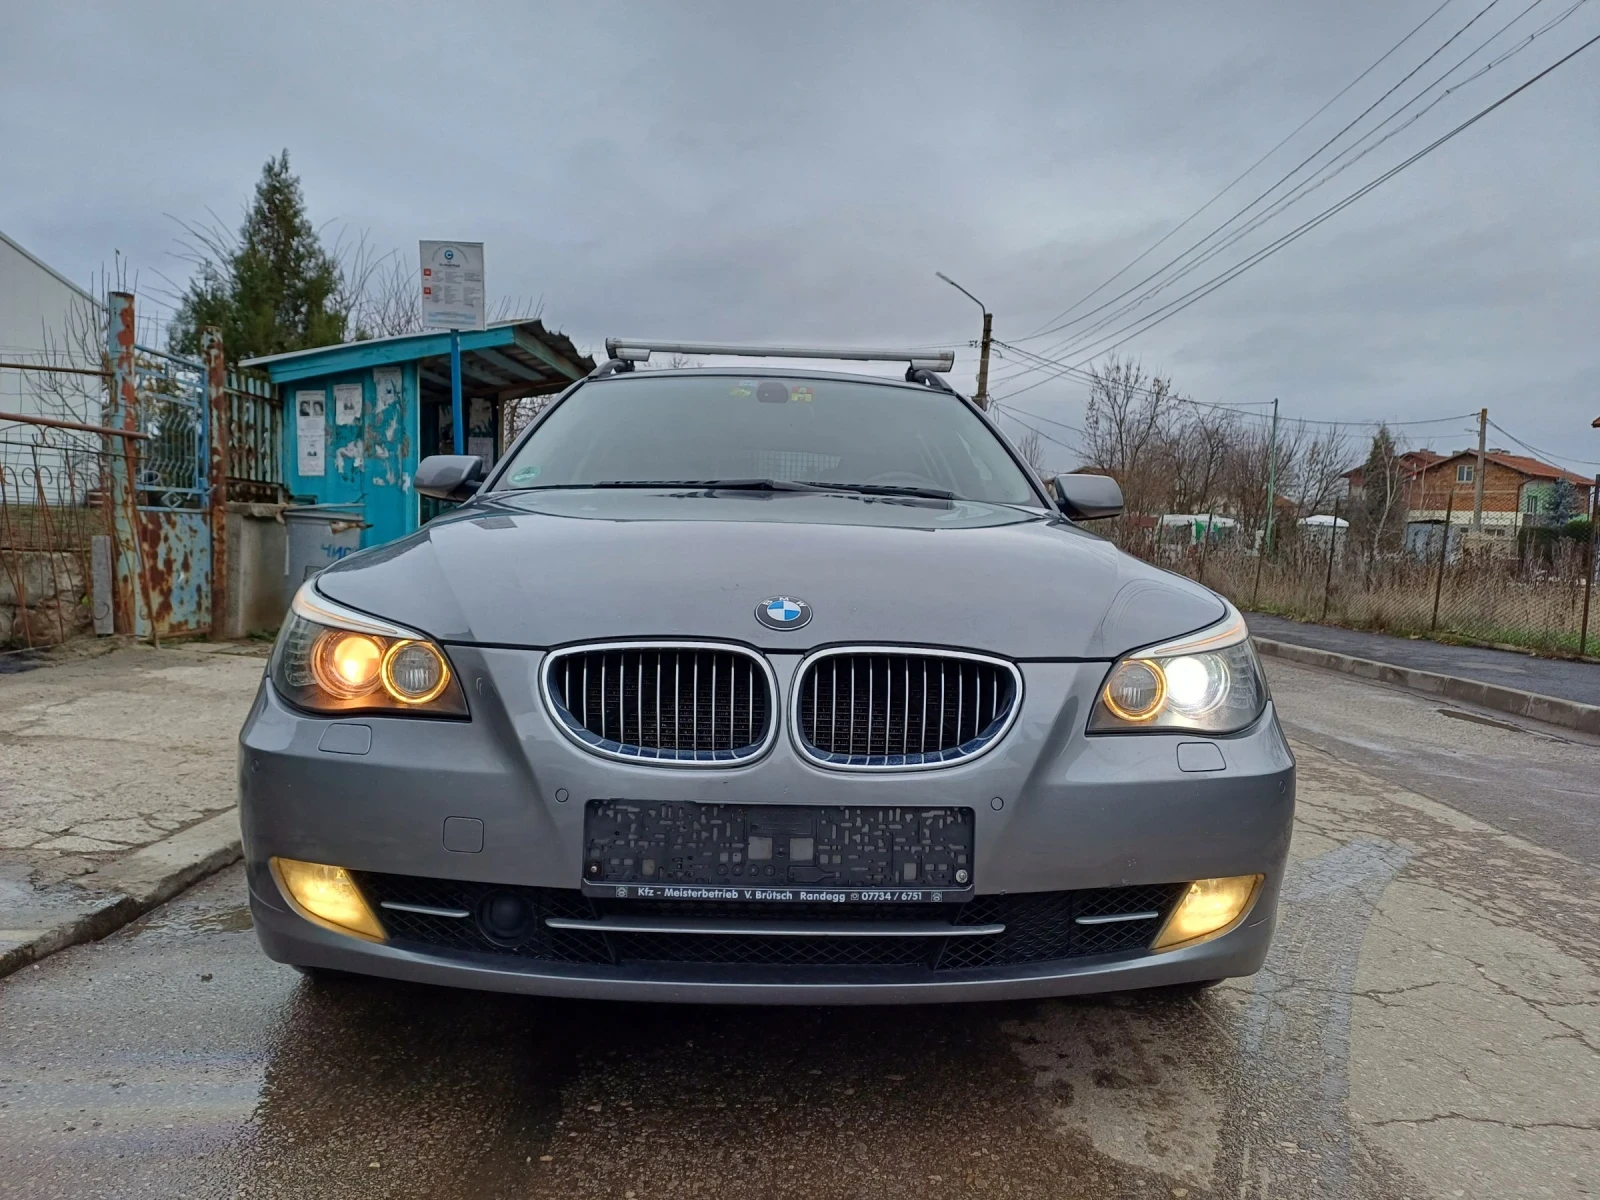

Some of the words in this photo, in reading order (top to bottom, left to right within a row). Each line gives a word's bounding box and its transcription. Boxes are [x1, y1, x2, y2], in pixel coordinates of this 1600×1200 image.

[762, 597, 807, 607] BMW
[637, 887, 654, 897] Kfz
[664, 888, 738, 899] Meisterbetrieb
[744, 890, 752, 899] V.
[755, 890, 793, 900] Brütsch
[800, 891, 846, 902] Randegg
[861, 892, 892, 901] 07734
[901, 892, 922, 901] 6751
